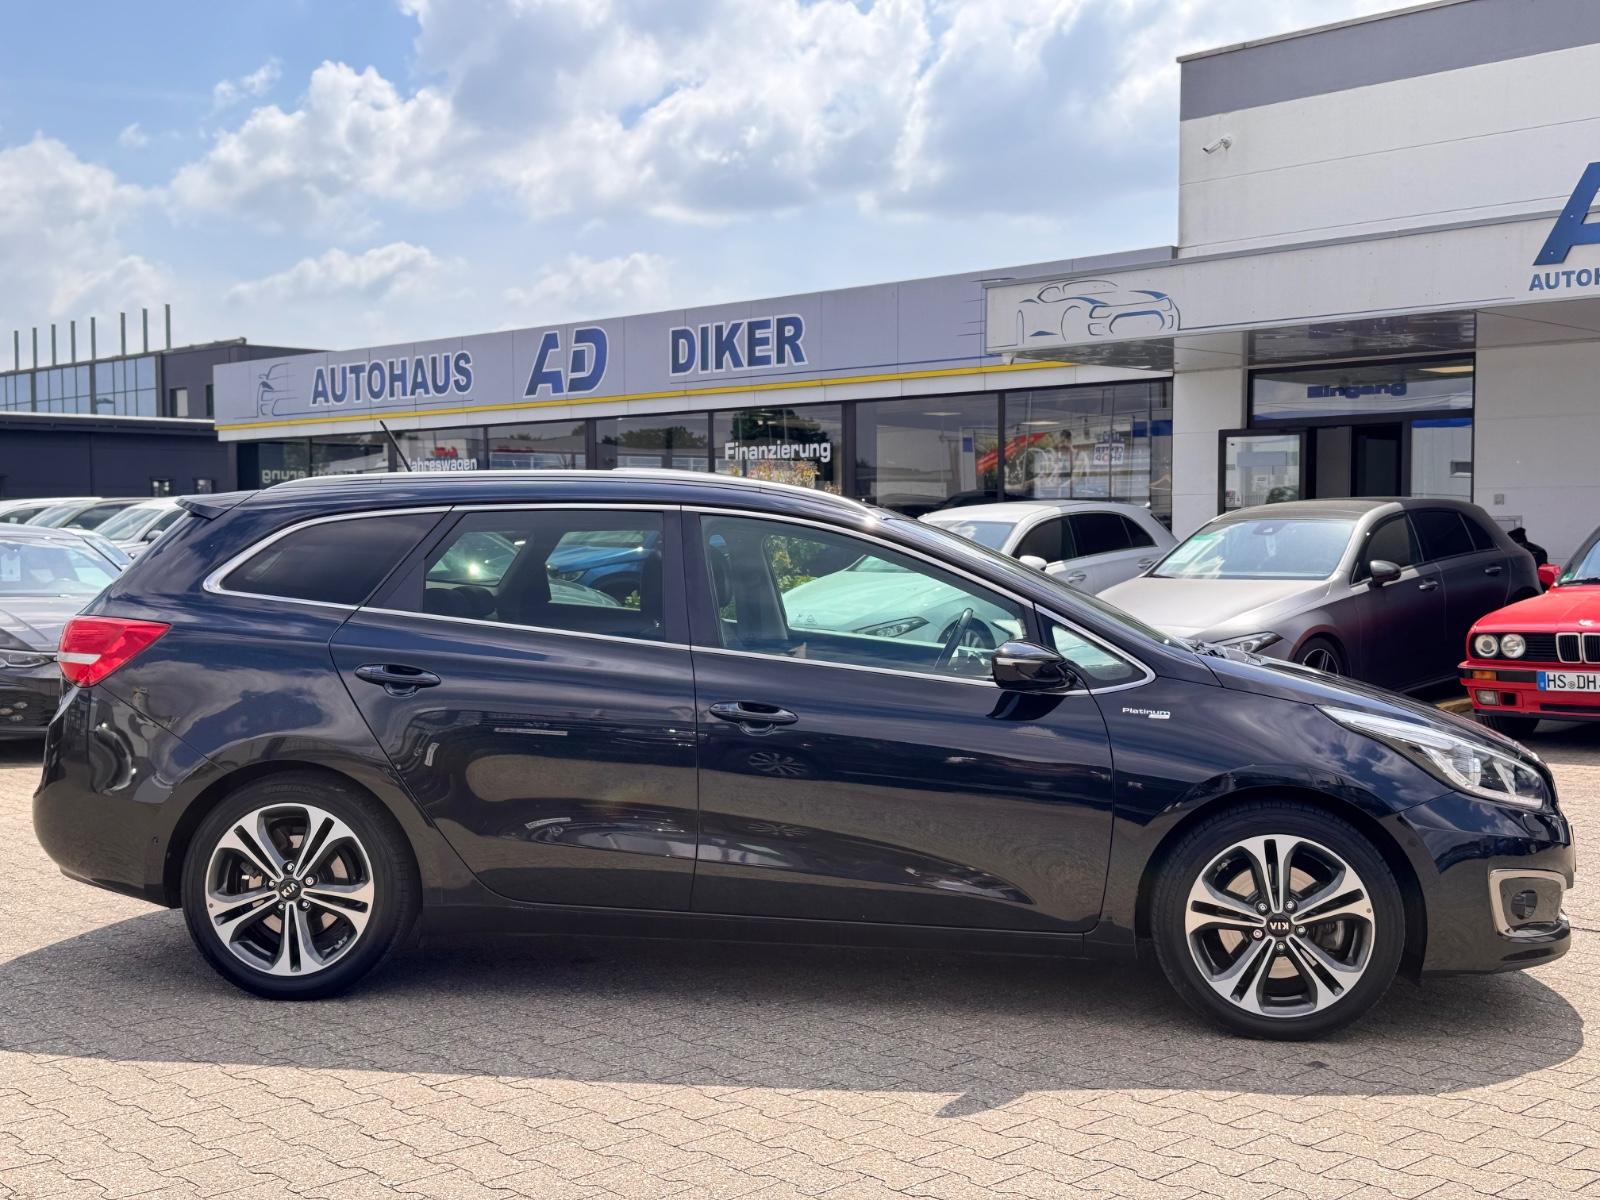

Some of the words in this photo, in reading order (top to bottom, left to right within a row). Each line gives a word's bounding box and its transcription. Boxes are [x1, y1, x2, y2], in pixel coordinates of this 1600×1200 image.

[311, 351, 473, 406] AUTOHAUS
[524, 327, 608, 397] AD
[670, 314, 808, 376] DIKER
[724, 440, 831, 463] Finanzierung
[1547, 674, 1567, 689] HS
[1122, 707, 1170, 716] Platinum
[281, 882, 298, 898] KIA
[1269, 922, 1289, 930] KIA
